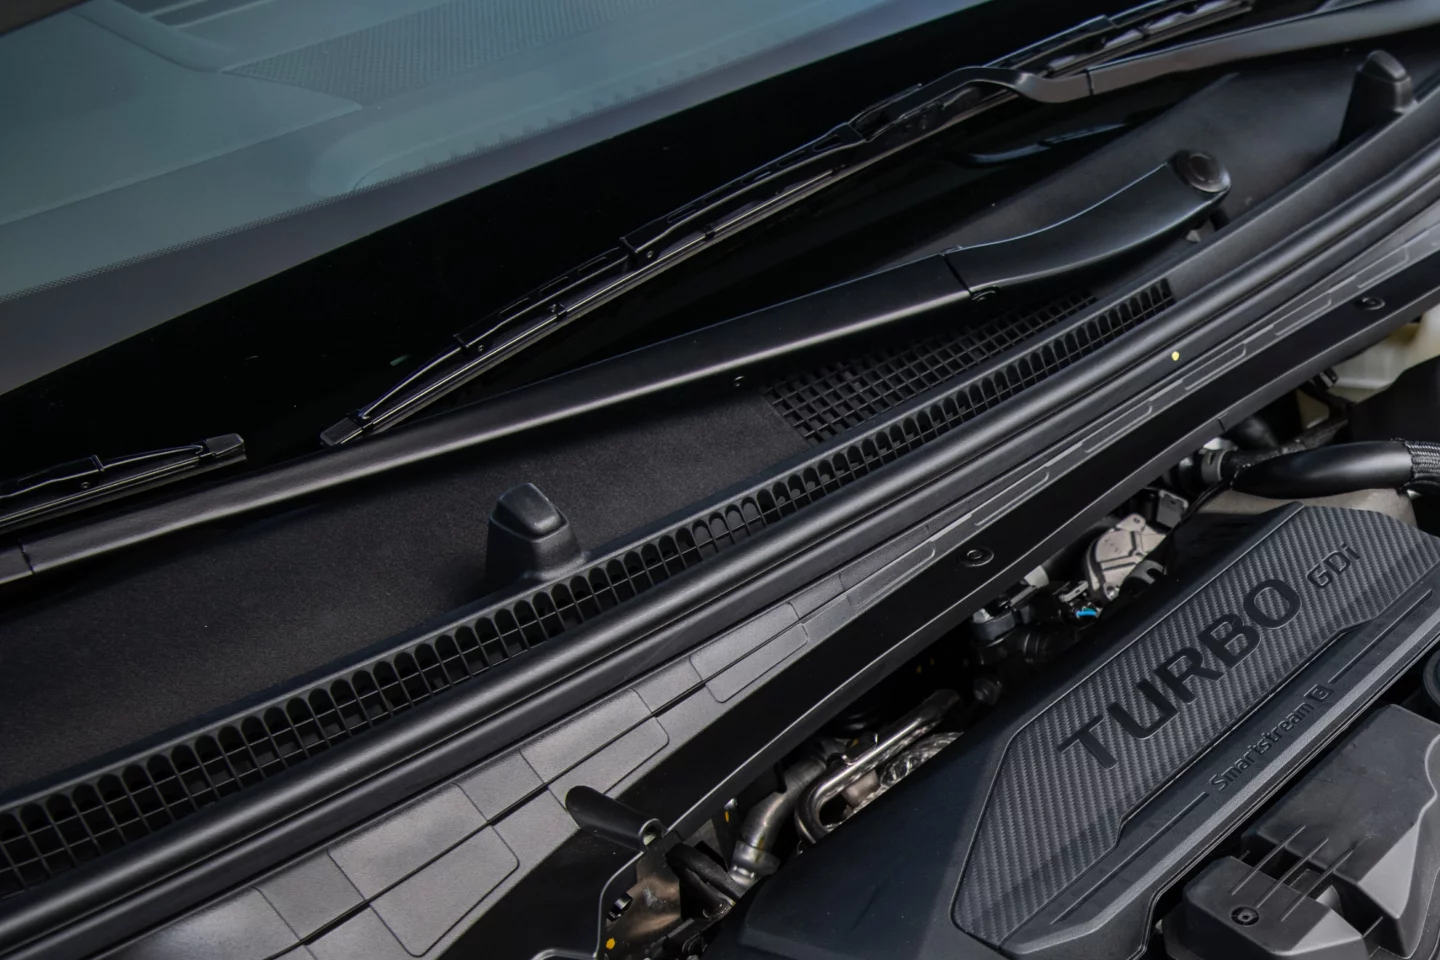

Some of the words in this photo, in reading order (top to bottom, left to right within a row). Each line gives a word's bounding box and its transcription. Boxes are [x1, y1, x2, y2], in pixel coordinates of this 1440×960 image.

[1057, 578, 1301, 769] TURBO
[1306, 543, 1361, 589] GDi
[1208, 702, 1315, 791] Smartstream
